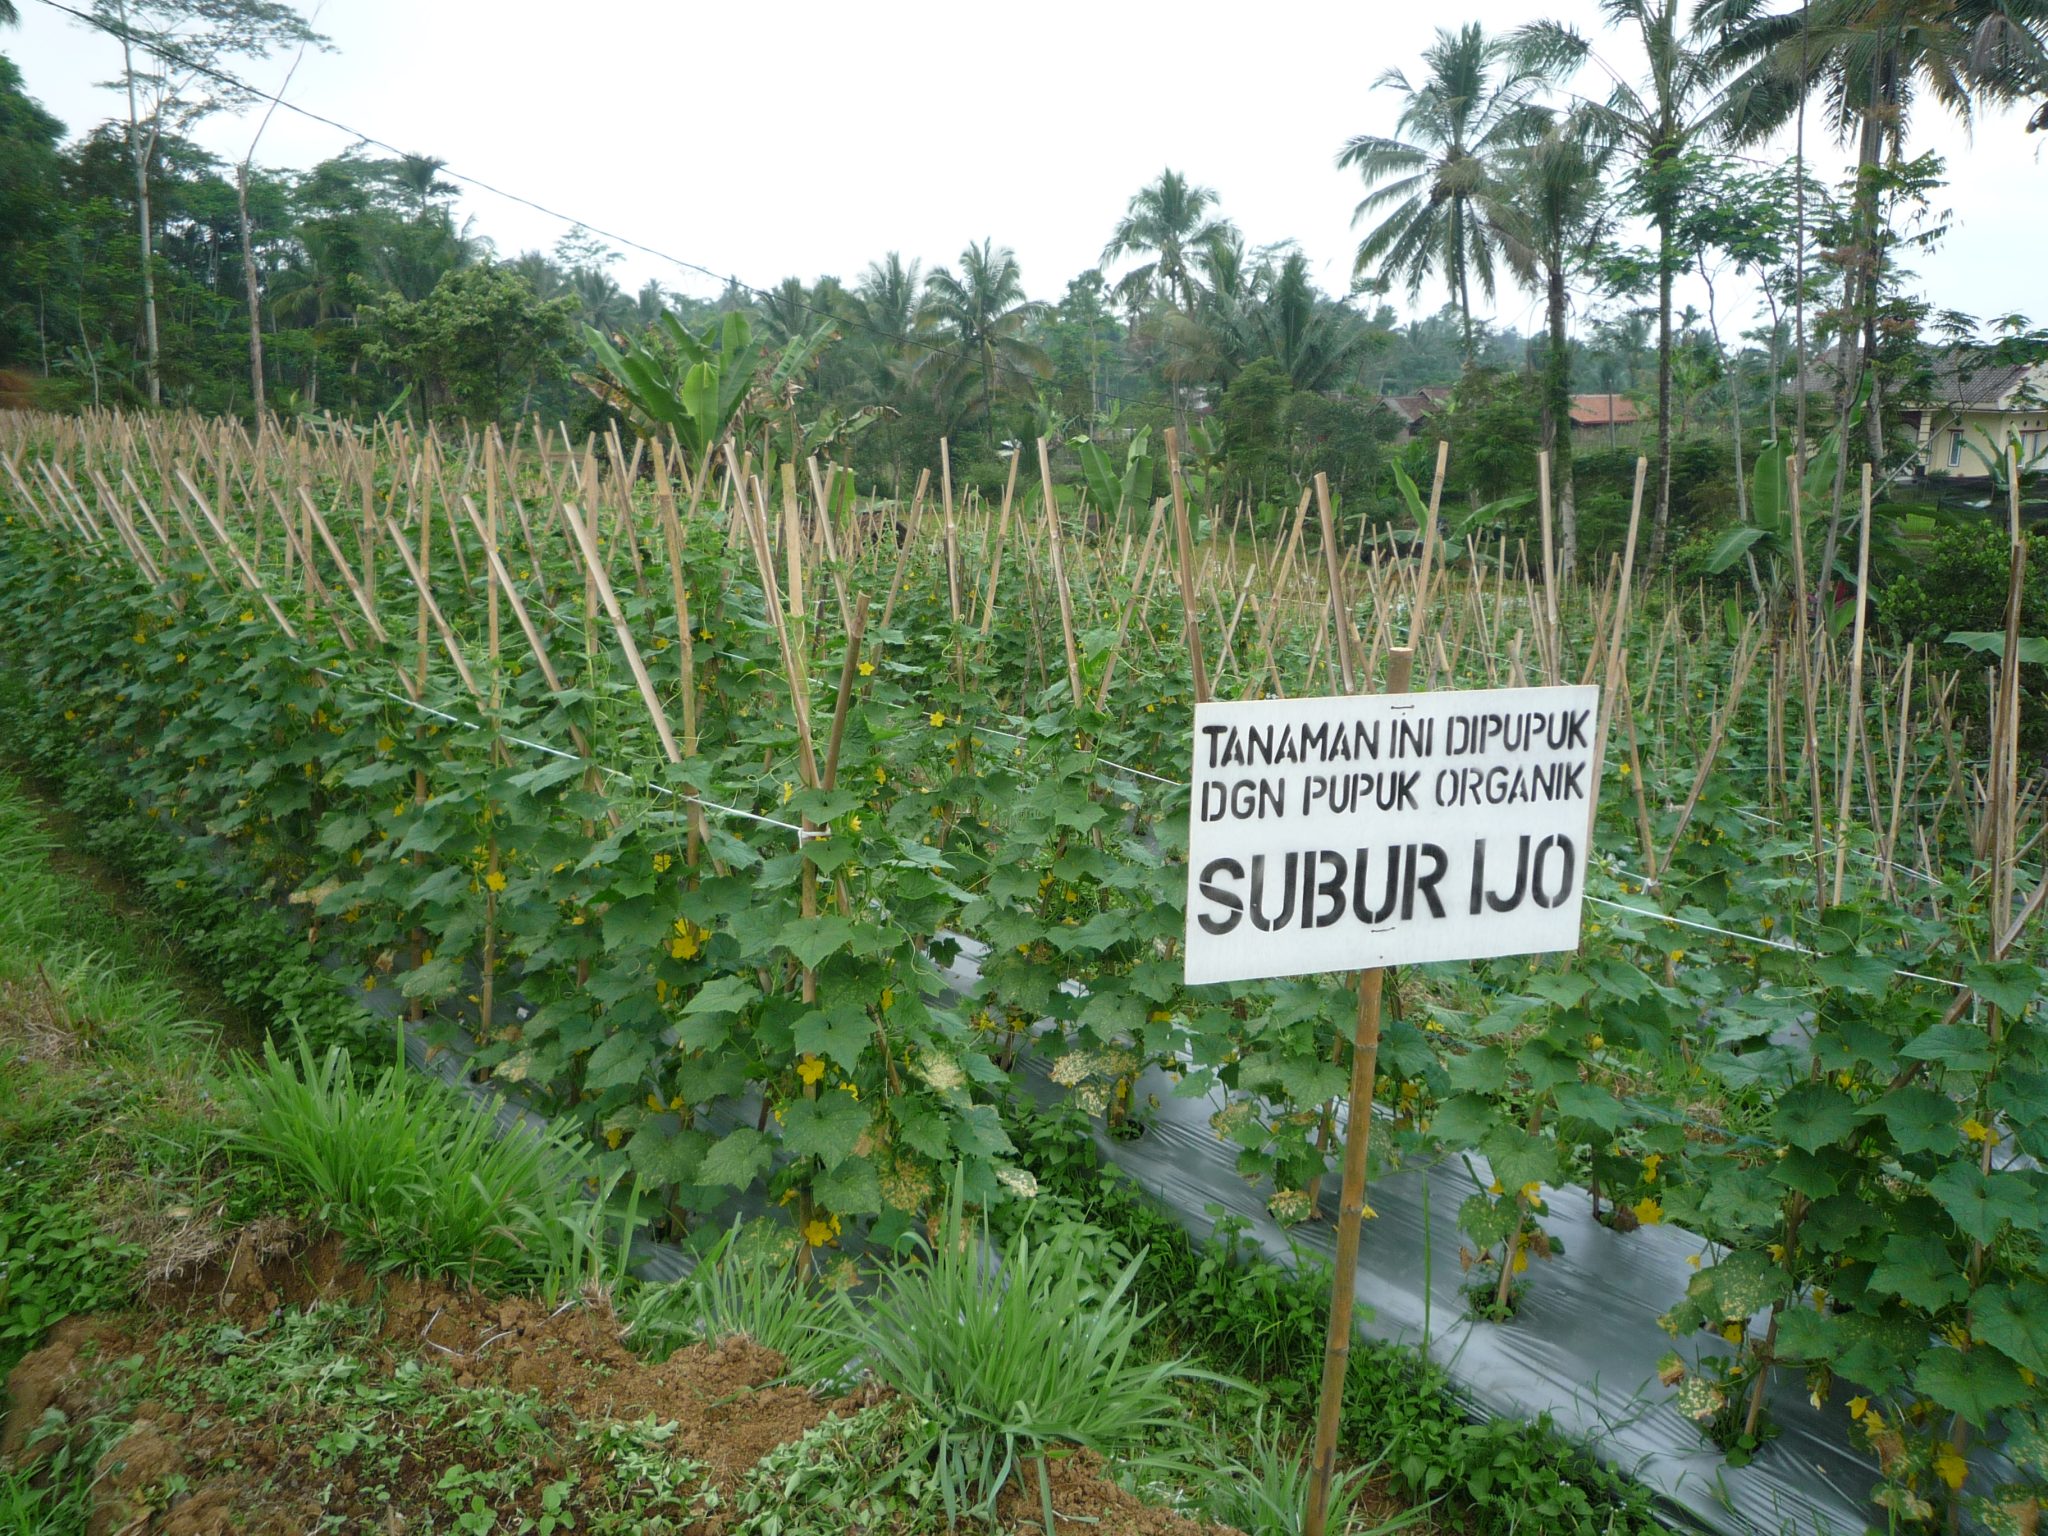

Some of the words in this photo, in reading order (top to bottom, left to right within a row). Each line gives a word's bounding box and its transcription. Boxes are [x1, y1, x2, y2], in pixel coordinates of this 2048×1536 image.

[1202, 720, 1380, 768] TANAMAN
[1390, 717, 1434, 759] INI
[1445, 709, 1591, 756] DIPUPUK
[1200, 778, 1285, 822] DGN
[1303, 770, 1421, 816] PUPUK
[1435, 761, 1586, 807] ORGANIK
[1197, 842, 1449, 936] SUBUR
[1469, 833, 1575, 915] IJO
